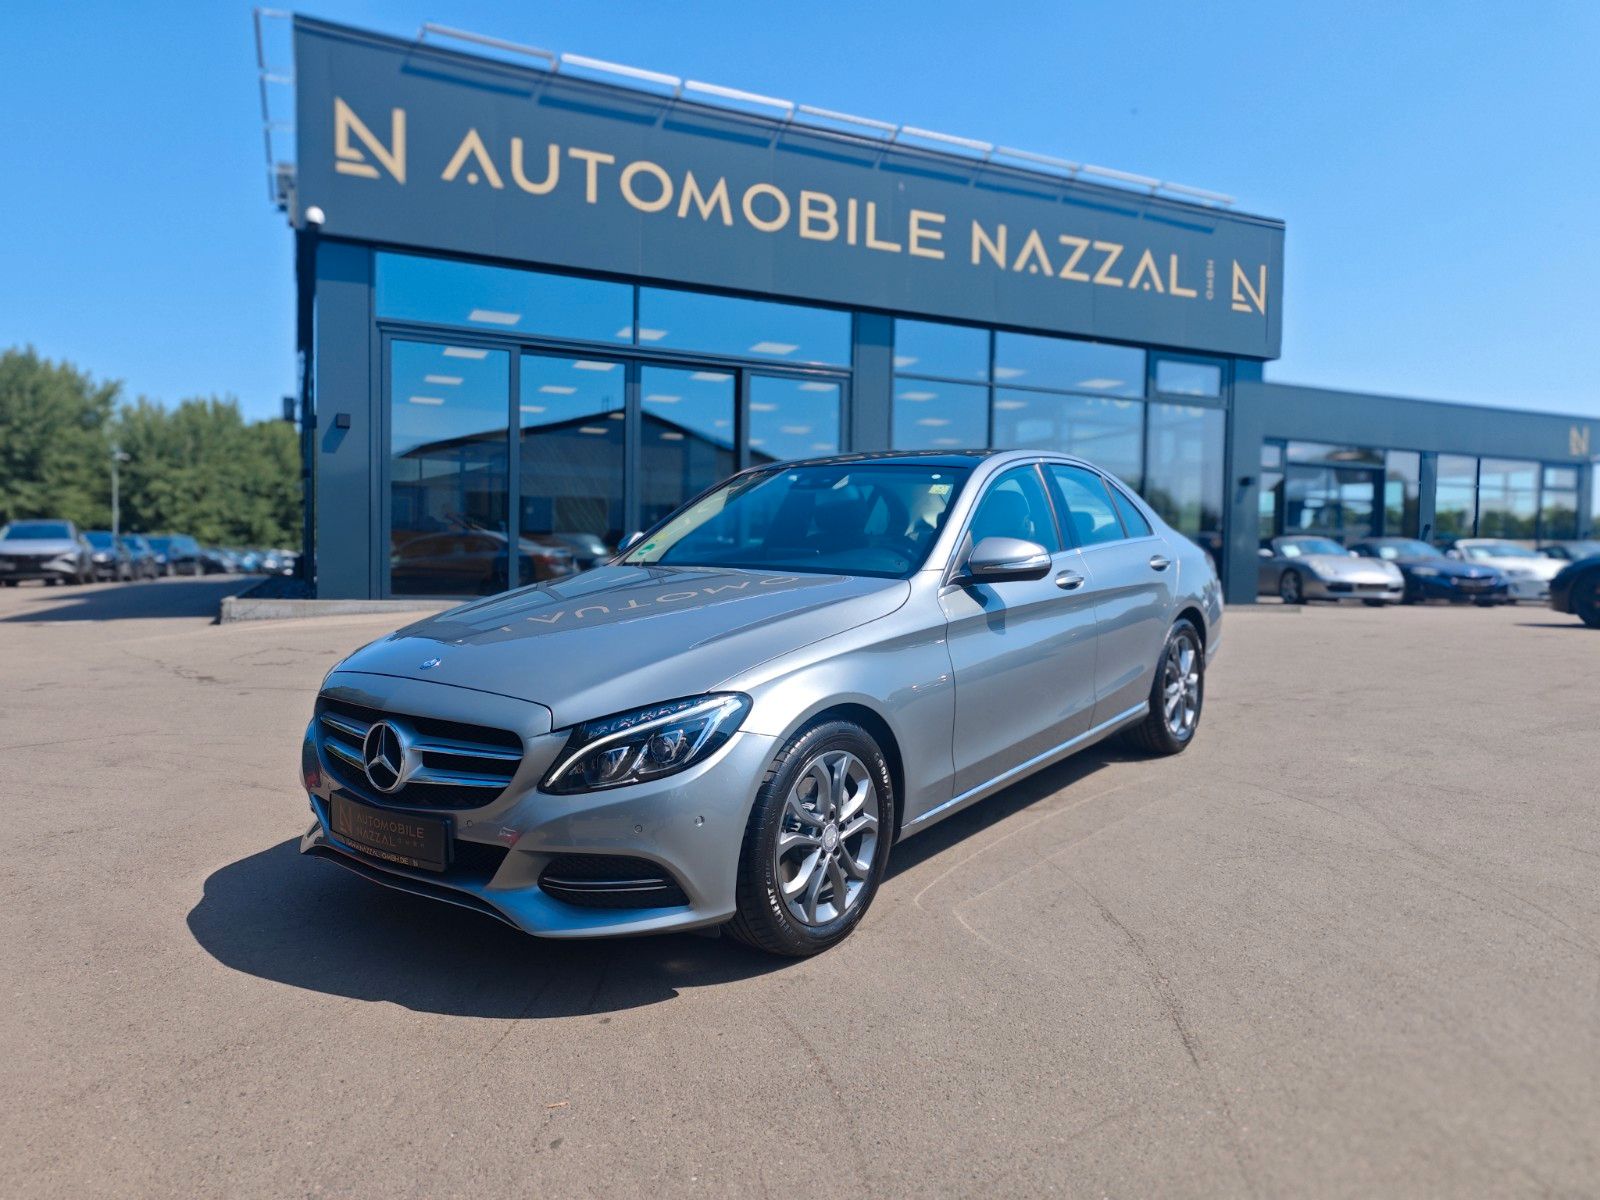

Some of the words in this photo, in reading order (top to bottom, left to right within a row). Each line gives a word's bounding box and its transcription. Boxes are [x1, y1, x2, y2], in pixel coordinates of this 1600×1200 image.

[441, 128, 946, 260] AUTOMOBILE
[971, 220, 1197, 298] NAZZAL
[357, 815, 425, 839] AUTOMOBILE
